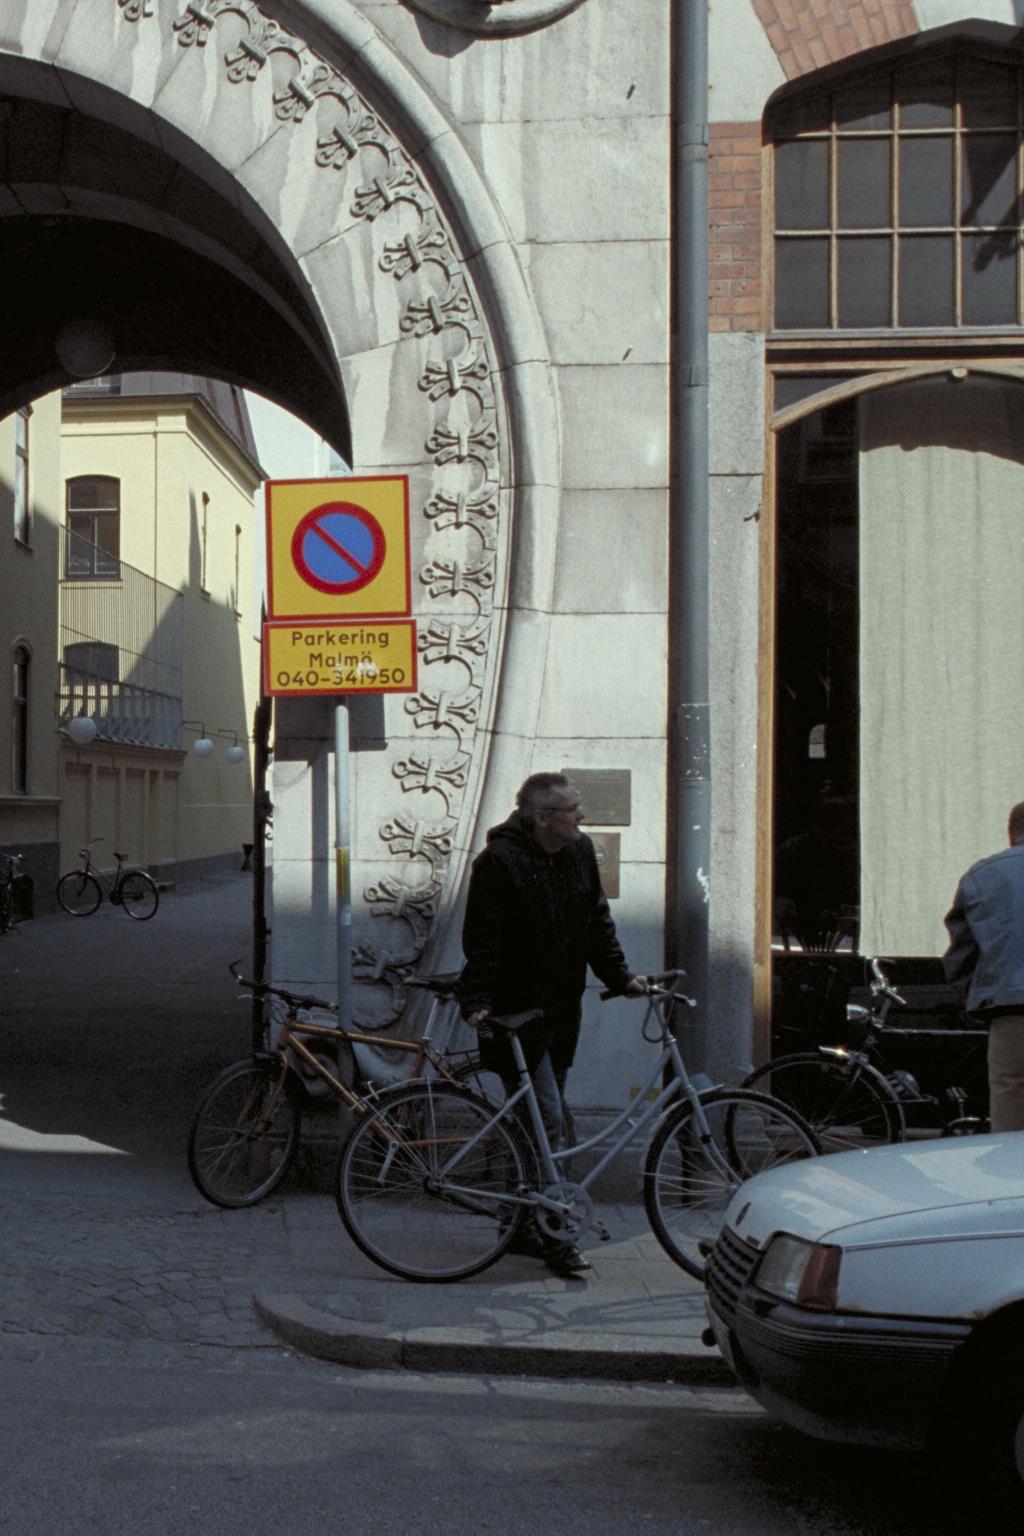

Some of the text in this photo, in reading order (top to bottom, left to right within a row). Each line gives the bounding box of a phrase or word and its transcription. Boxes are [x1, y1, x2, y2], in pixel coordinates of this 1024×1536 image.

[292, 629, 390, 648] Parkering
[309, 651, 373, 668] Malmö
[277, 667, 406, 687] 040-341950
